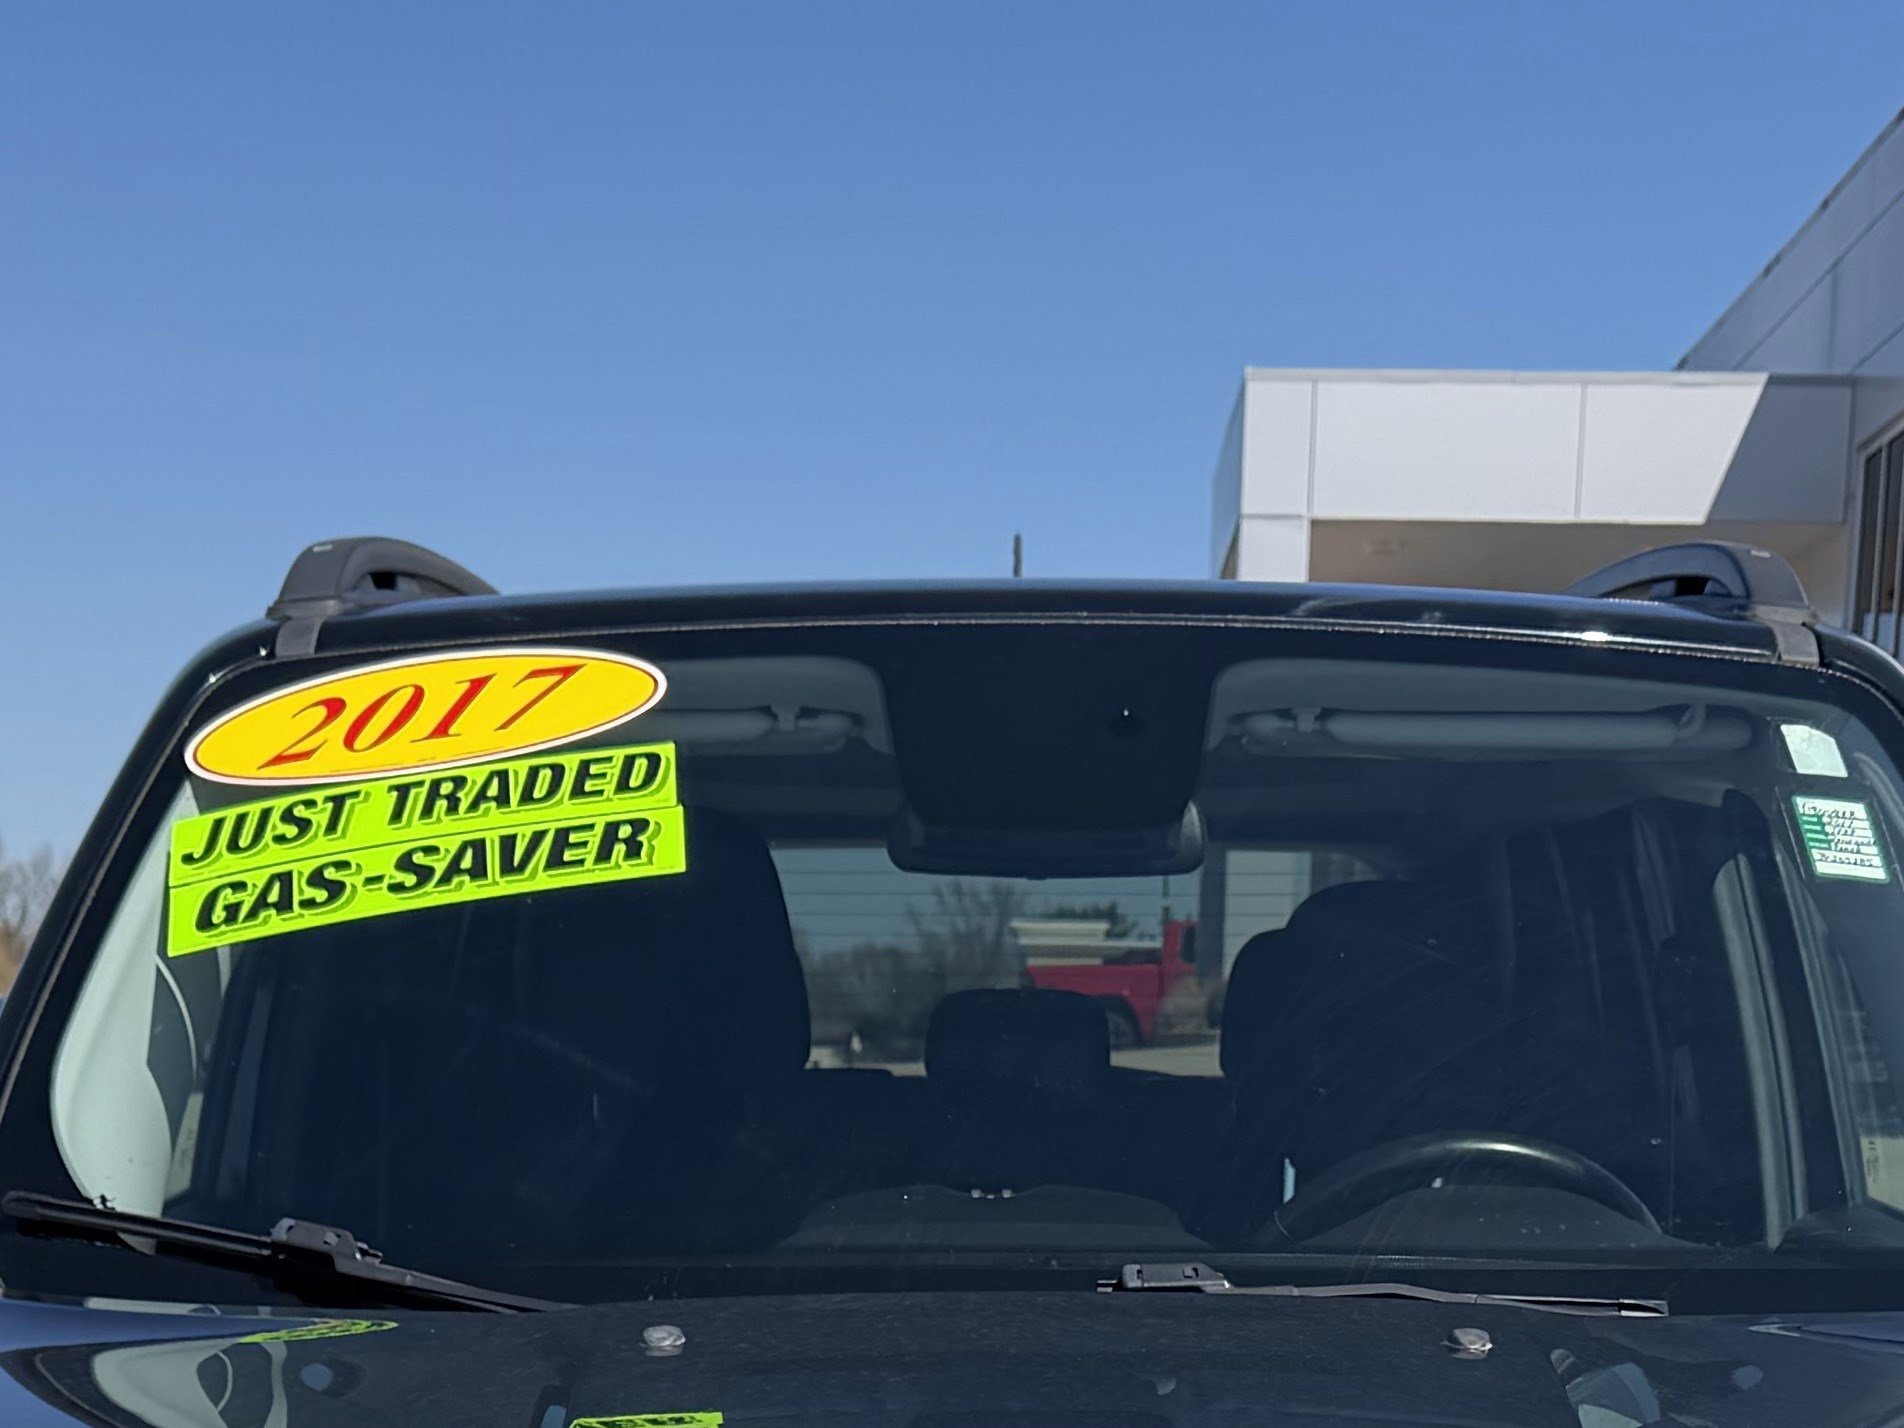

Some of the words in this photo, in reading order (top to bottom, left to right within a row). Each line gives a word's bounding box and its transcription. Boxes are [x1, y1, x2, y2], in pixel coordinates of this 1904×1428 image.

[259, 664, 586, 770] 2017
[181, 790, 368, 868] JUST
[386, 752, 665, 828] TRADED
[194, 814, 661, 937] GAS-SAVER
